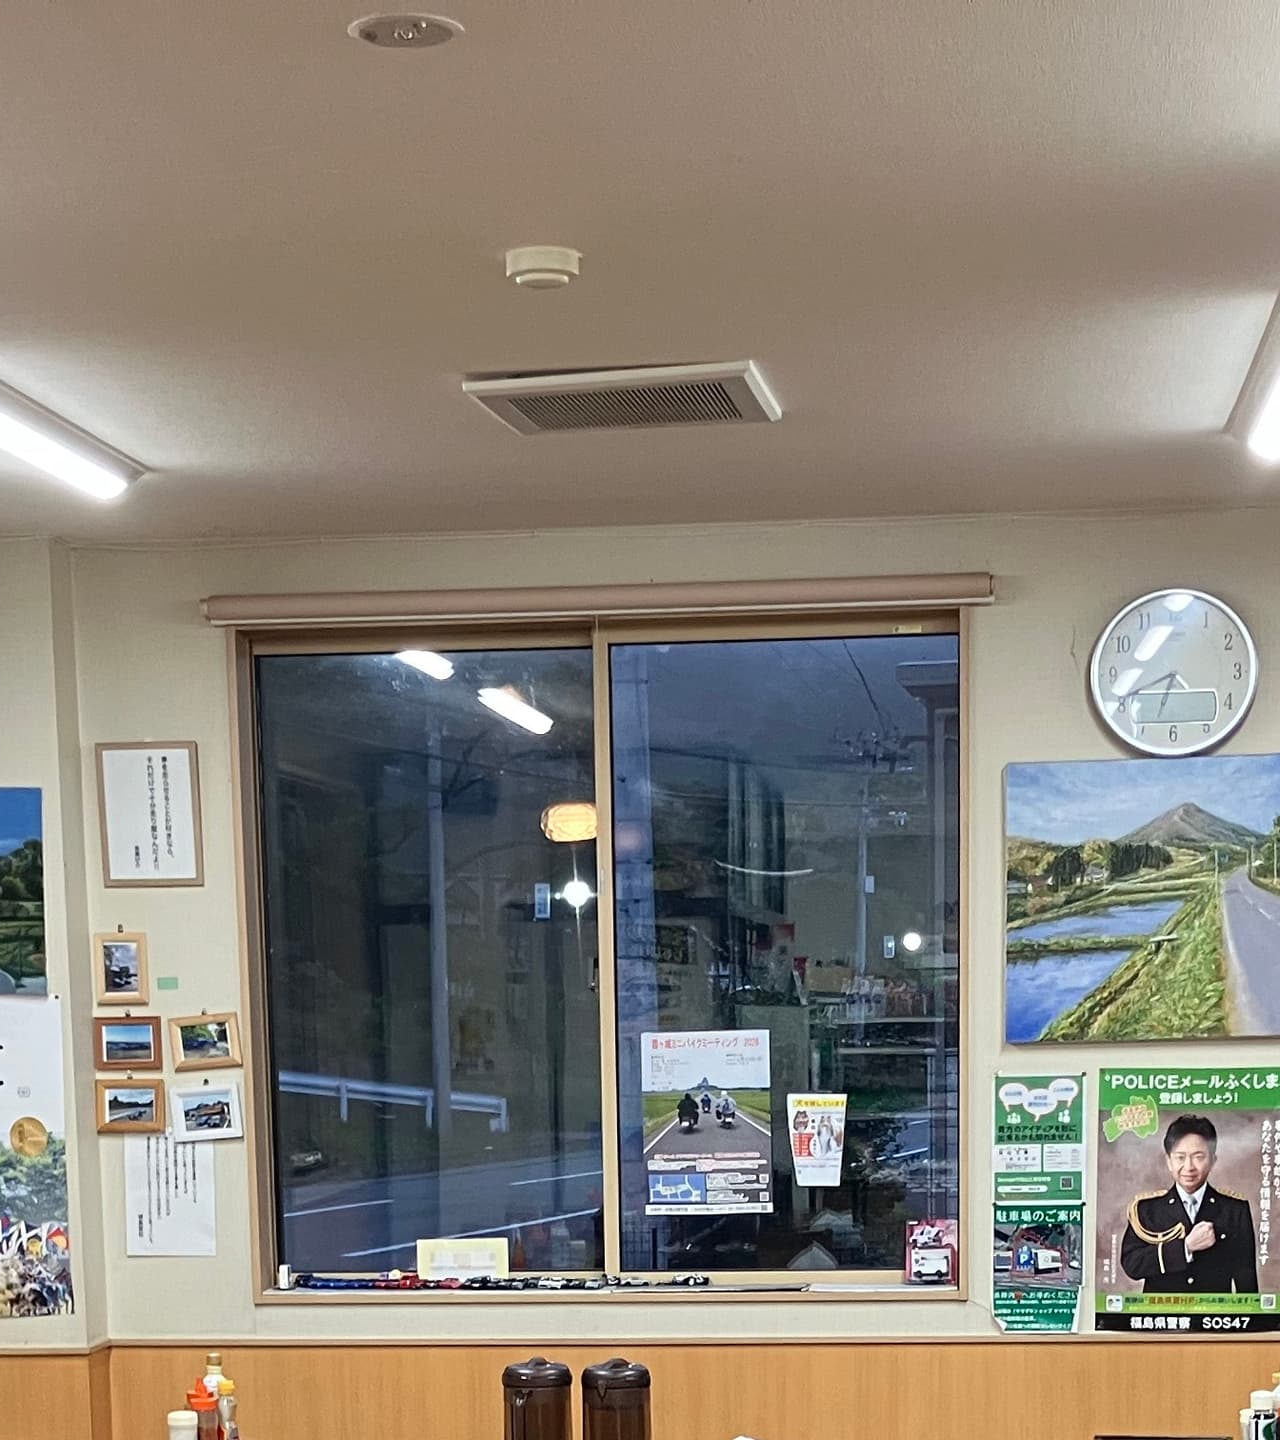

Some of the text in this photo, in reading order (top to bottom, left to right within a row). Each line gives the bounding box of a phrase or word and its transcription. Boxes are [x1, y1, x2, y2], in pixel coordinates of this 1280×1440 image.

[1224, 633, 1233, 651] 2
[1233, 662, 1242, 680] 3
[1223, 692, 1233, 710] 4
[1169, 725, 1178, 742] 6
[995, 1209, 1081, 1223] 駐車場のご案内
[1202, 1316, 1251, 1329] SOS47
